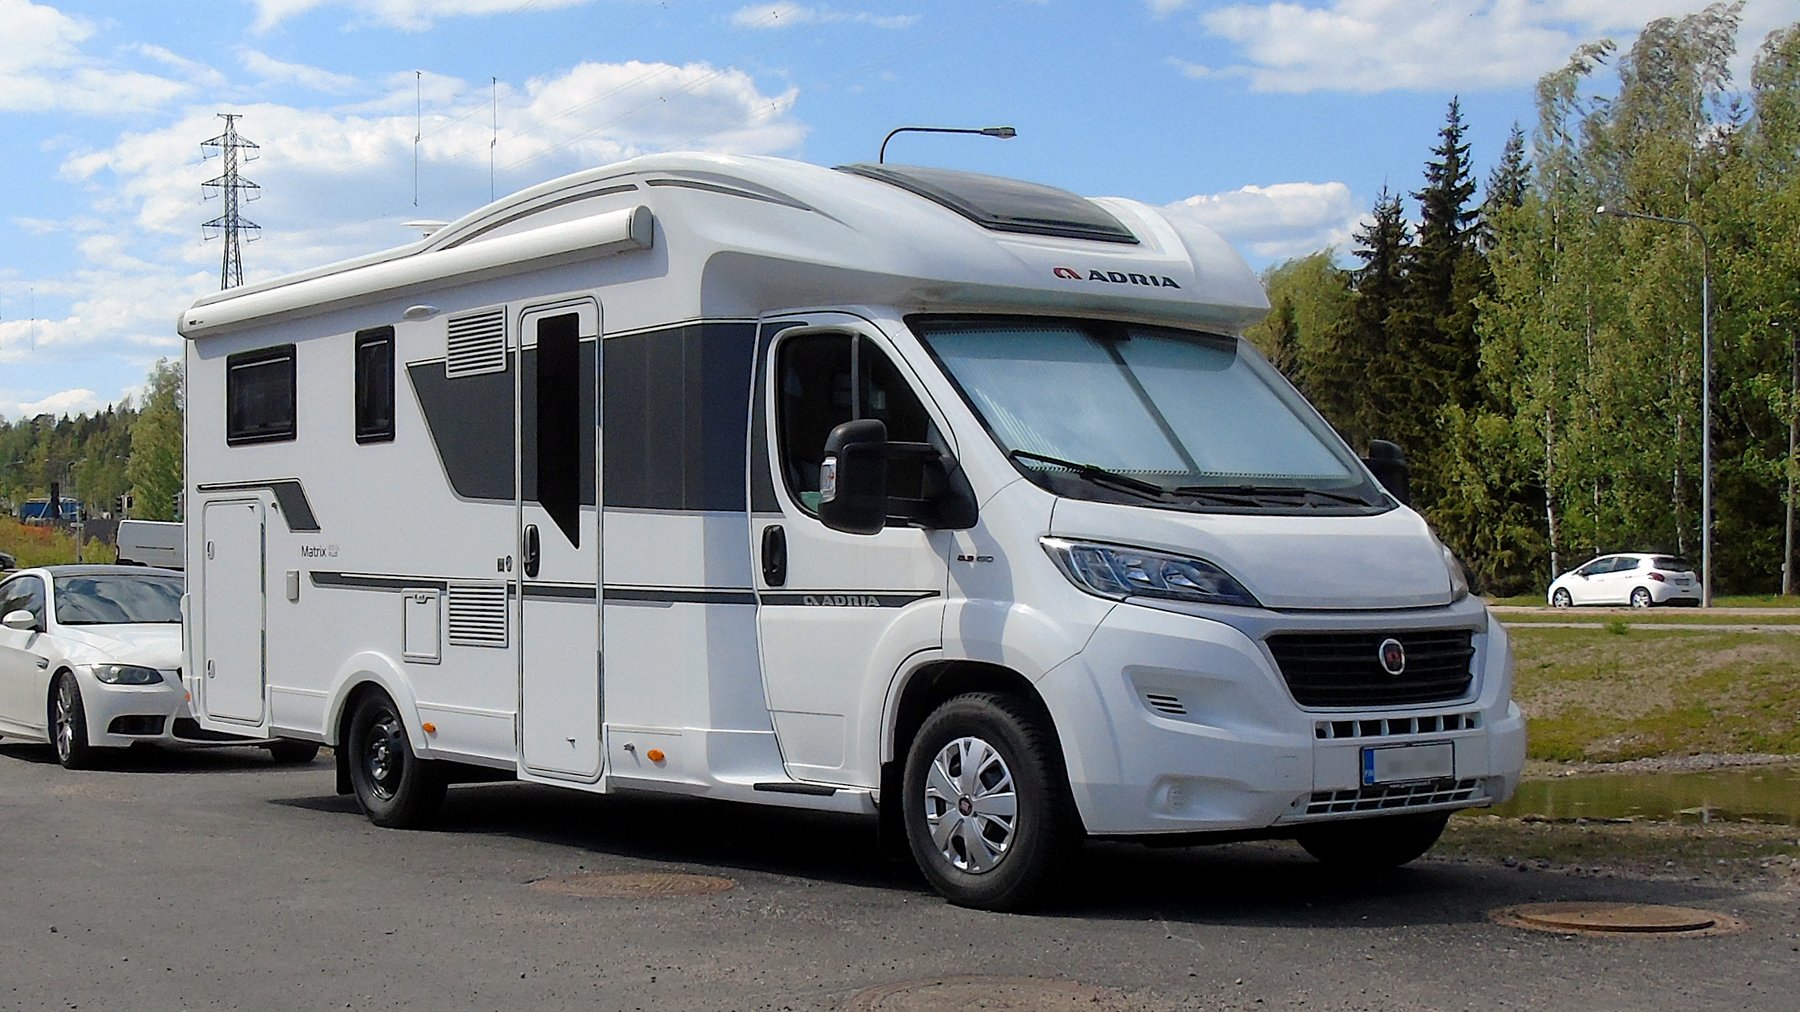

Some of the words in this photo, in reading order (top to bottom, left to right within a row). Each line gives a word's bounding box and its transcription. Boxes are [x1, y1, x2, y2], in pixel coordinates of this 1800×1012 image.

[1088, 269, 1181, 289] ADRIA
[301, 545, 327, 558] Matrix
[822, 595, 880, 606] ADRIA
